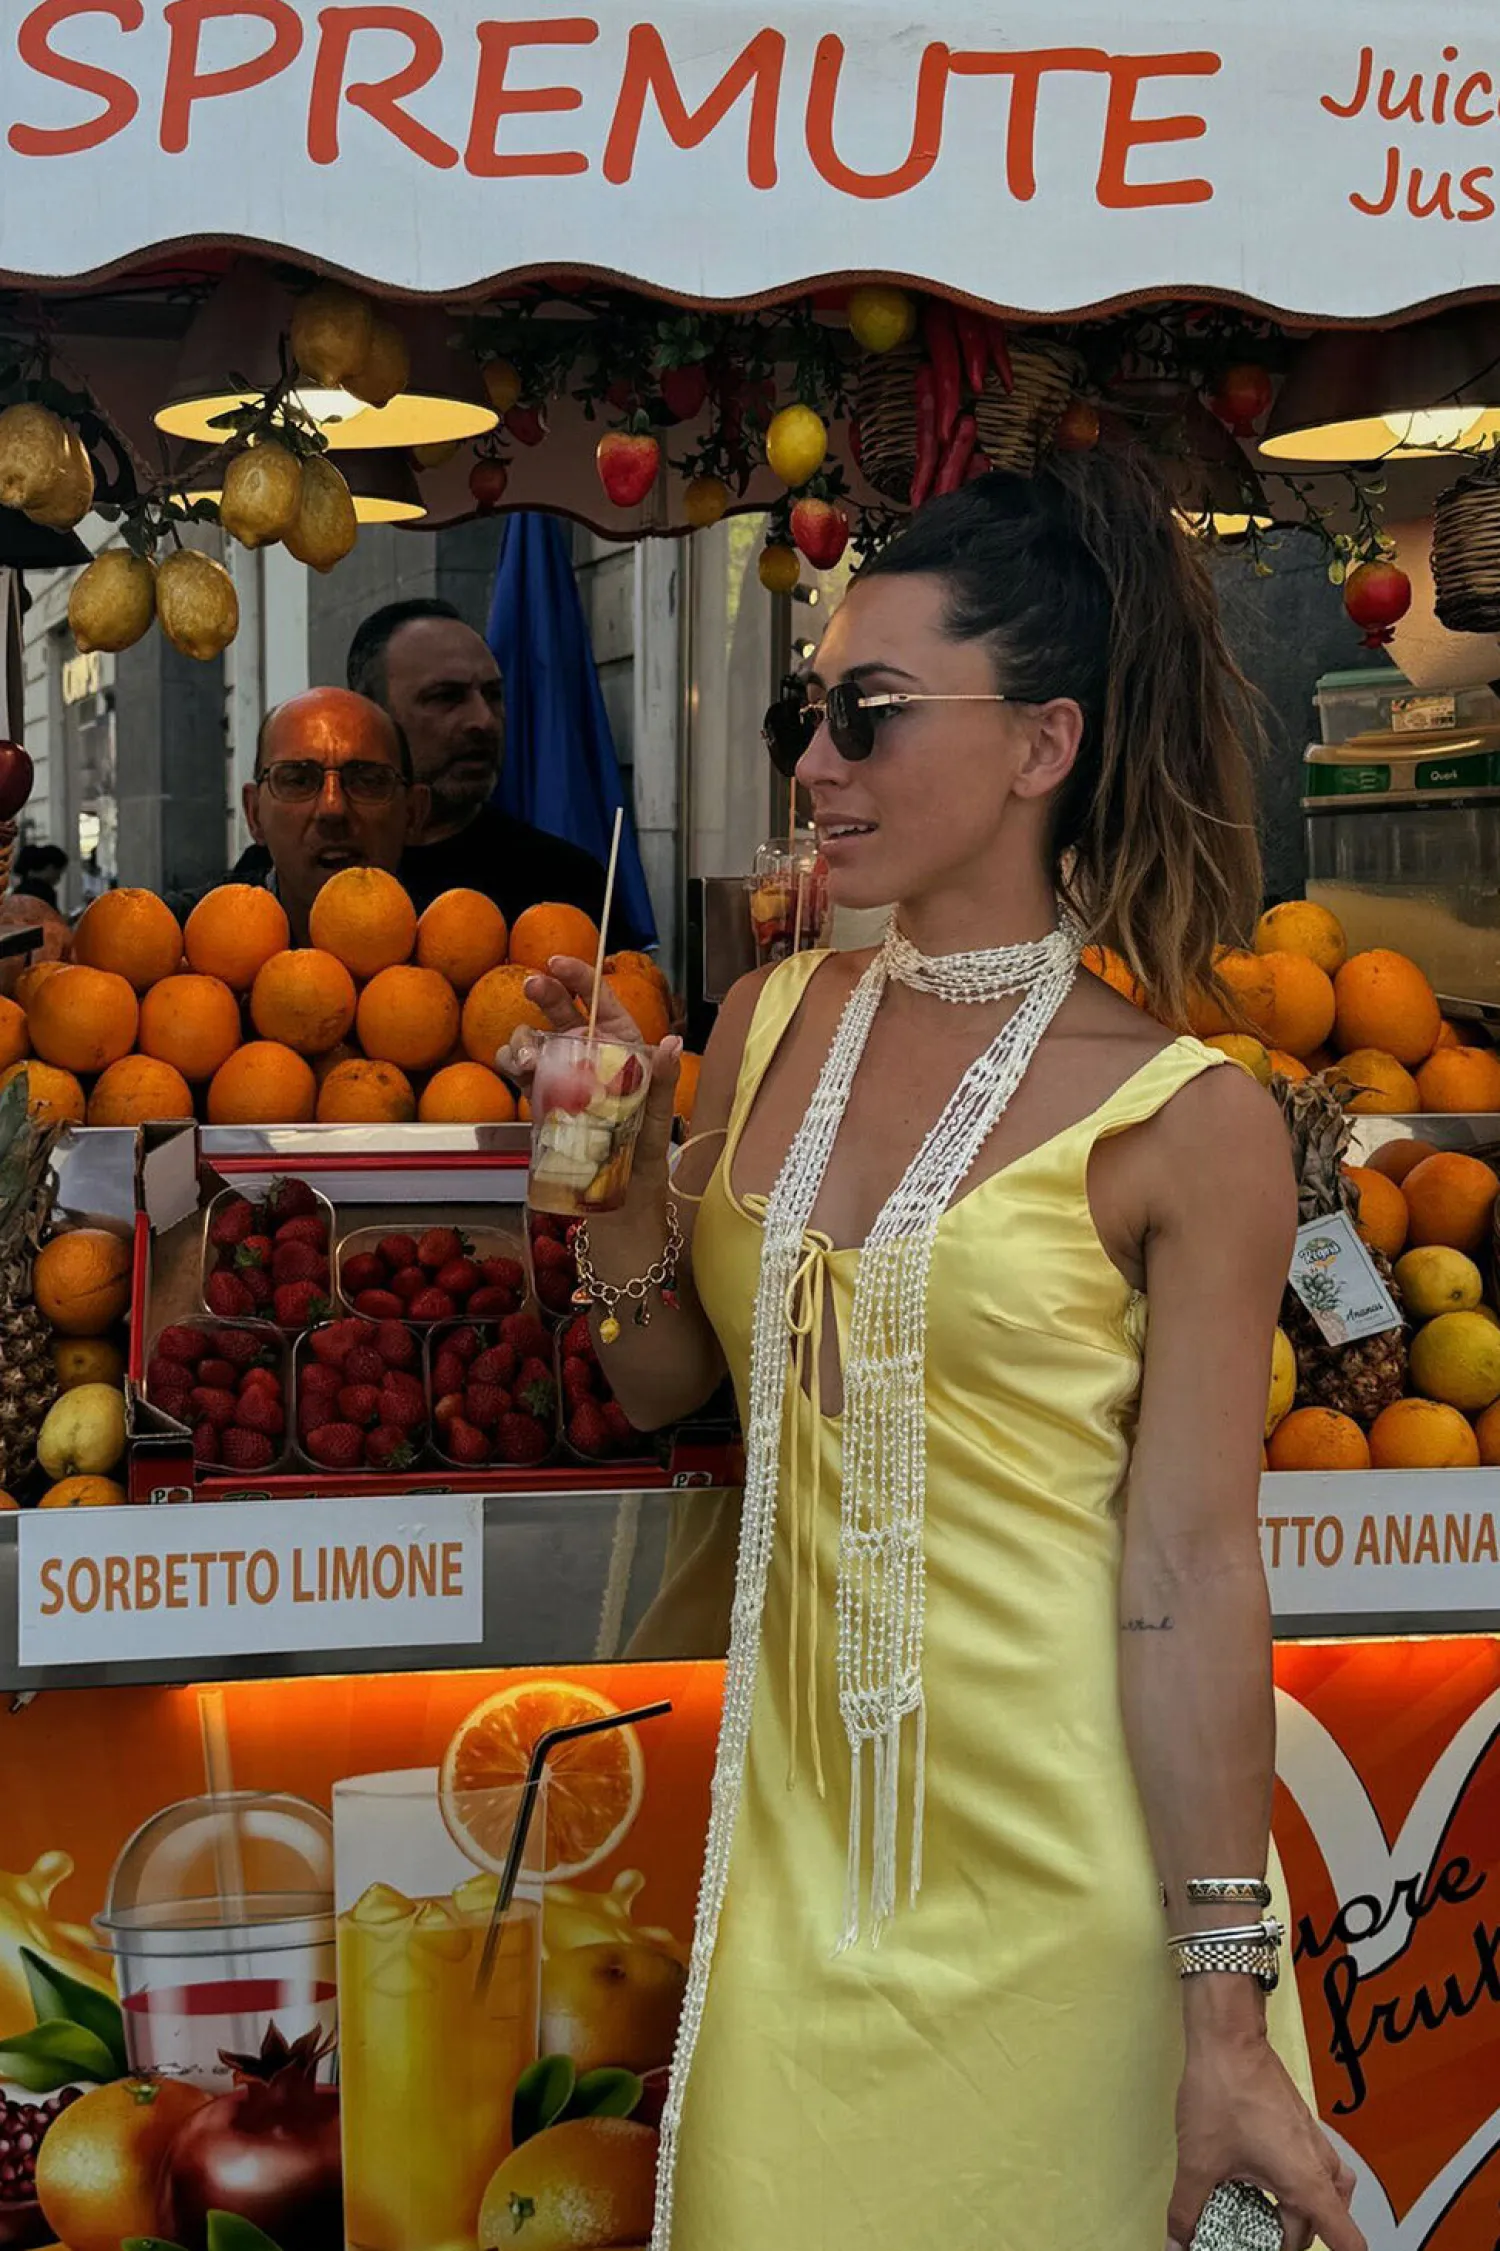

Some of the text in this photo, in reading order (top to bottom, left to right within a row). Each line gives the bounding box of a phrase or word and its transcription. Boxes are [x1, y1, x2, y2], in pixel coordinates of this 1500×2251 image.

[9, 0, 1221, 208] SPREMUTE
[1320, 46, 1500, 127] Juic
[1349, 147, 1495, 221] Jus
[1258, 1513, 1498, 1568] TTO ANANA
[40, 1542, 463, 1616] SORBETTO LIMONE
